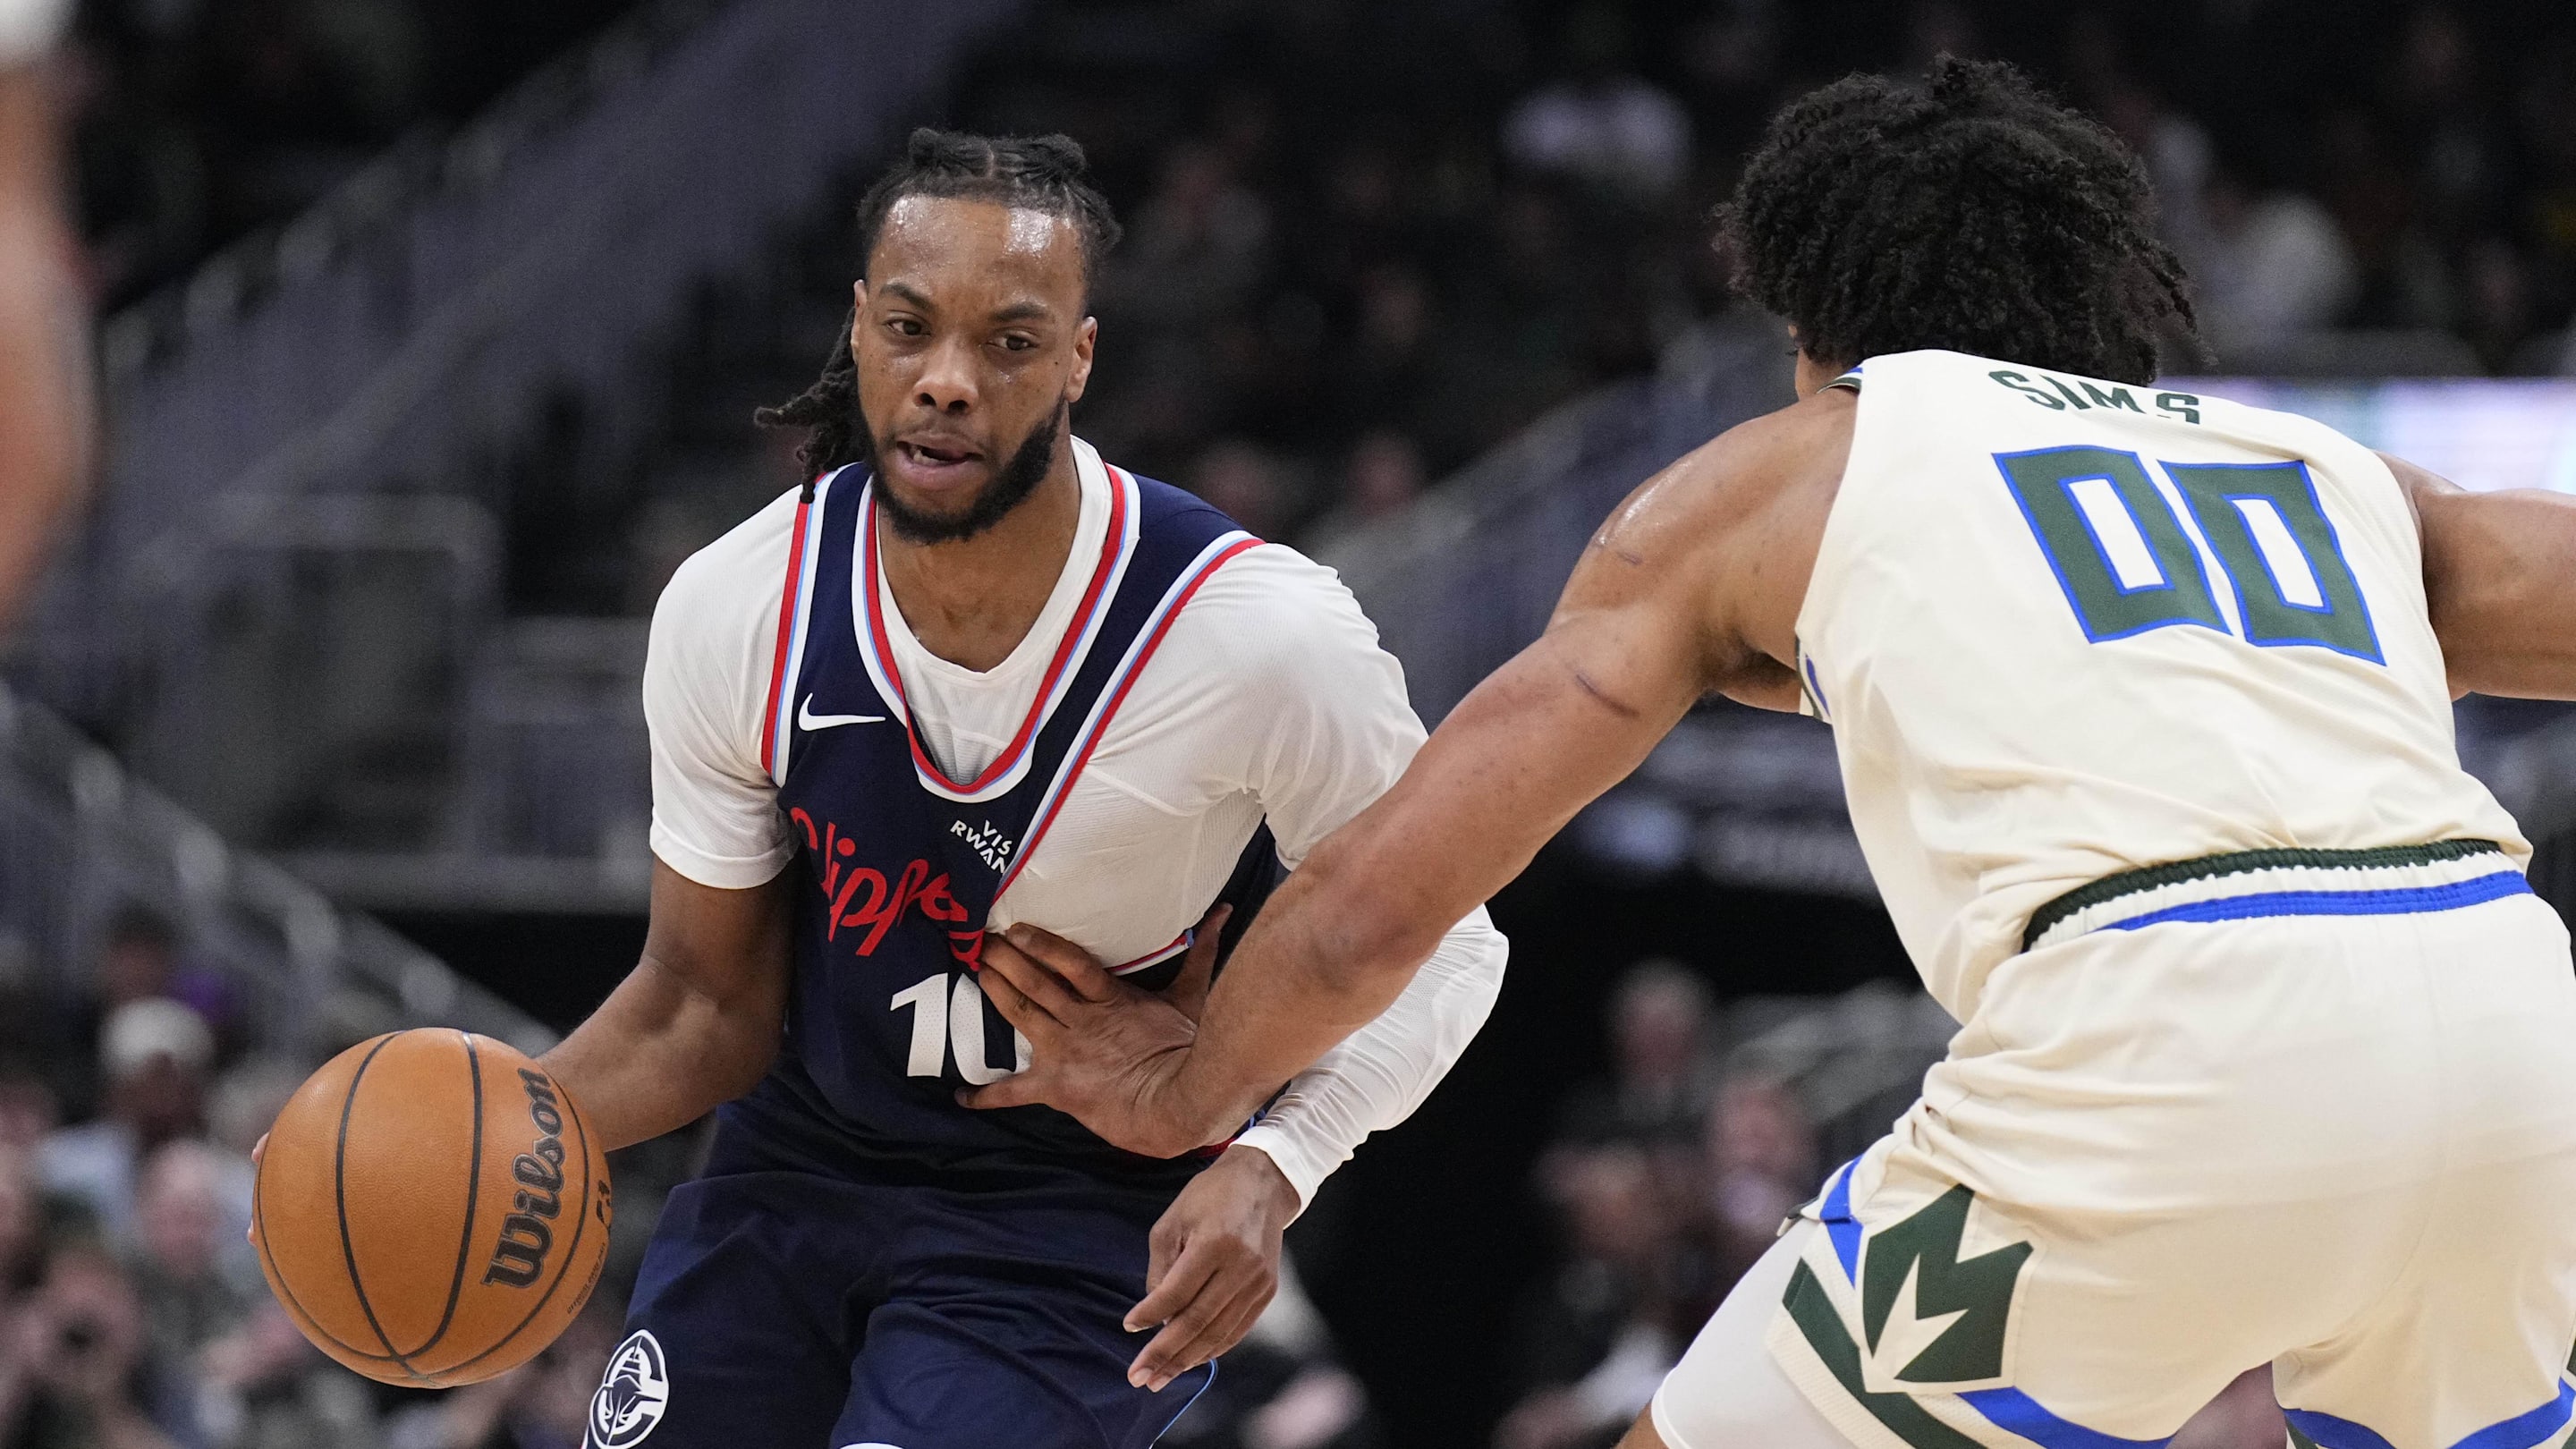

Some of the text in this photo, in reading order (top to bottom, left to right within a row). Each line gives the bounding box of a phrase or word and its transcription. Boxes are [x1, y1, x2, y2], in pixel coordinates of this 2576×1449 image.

[1988, 369, 2201, 425] SIMS
[1991, 444, 2387, 666] 00
[983, 819, 1013, 855] VIS
[890, 972, 1034, 1086] 10
[480, 1067, 566, 1289] Wilson
